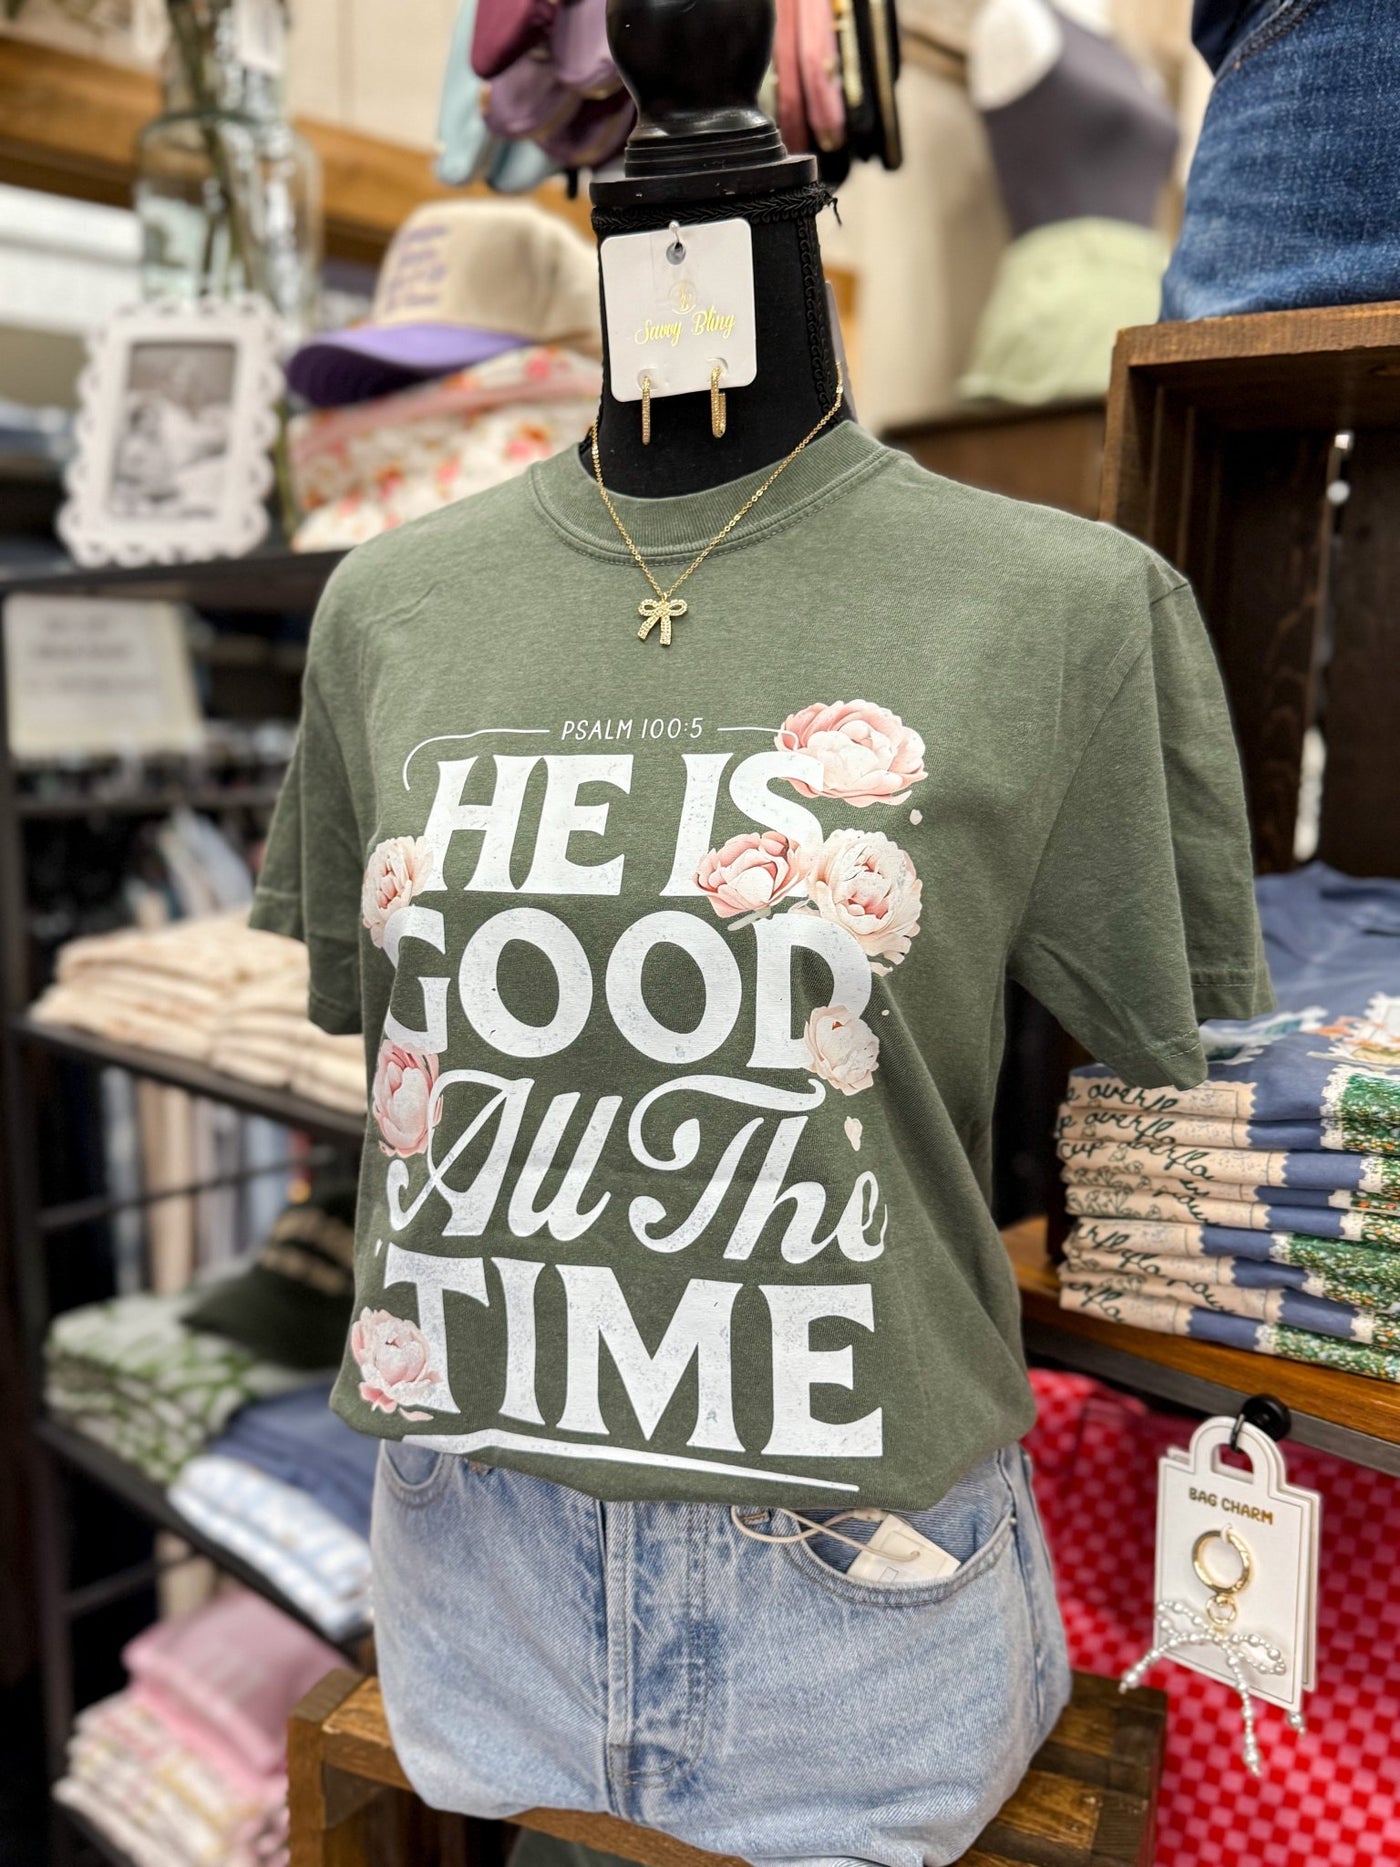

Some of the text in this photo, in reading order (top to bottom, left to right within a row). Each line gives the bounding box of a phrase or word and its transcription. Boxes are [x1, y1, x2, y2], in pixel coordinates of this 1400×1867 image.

[634, 305, 735, 347] Savvy Bling
[561, 717, 704, 741] PSALM 100:5
[422, 751, 826, 899] HE IS
[382, 906, 872, 1070] GOOD
[386, 1068, 888, 1265] All The
[383, 1241, 883, 1457] TIME
[1188, 1487, 1273, 1525] BAG CHARM
